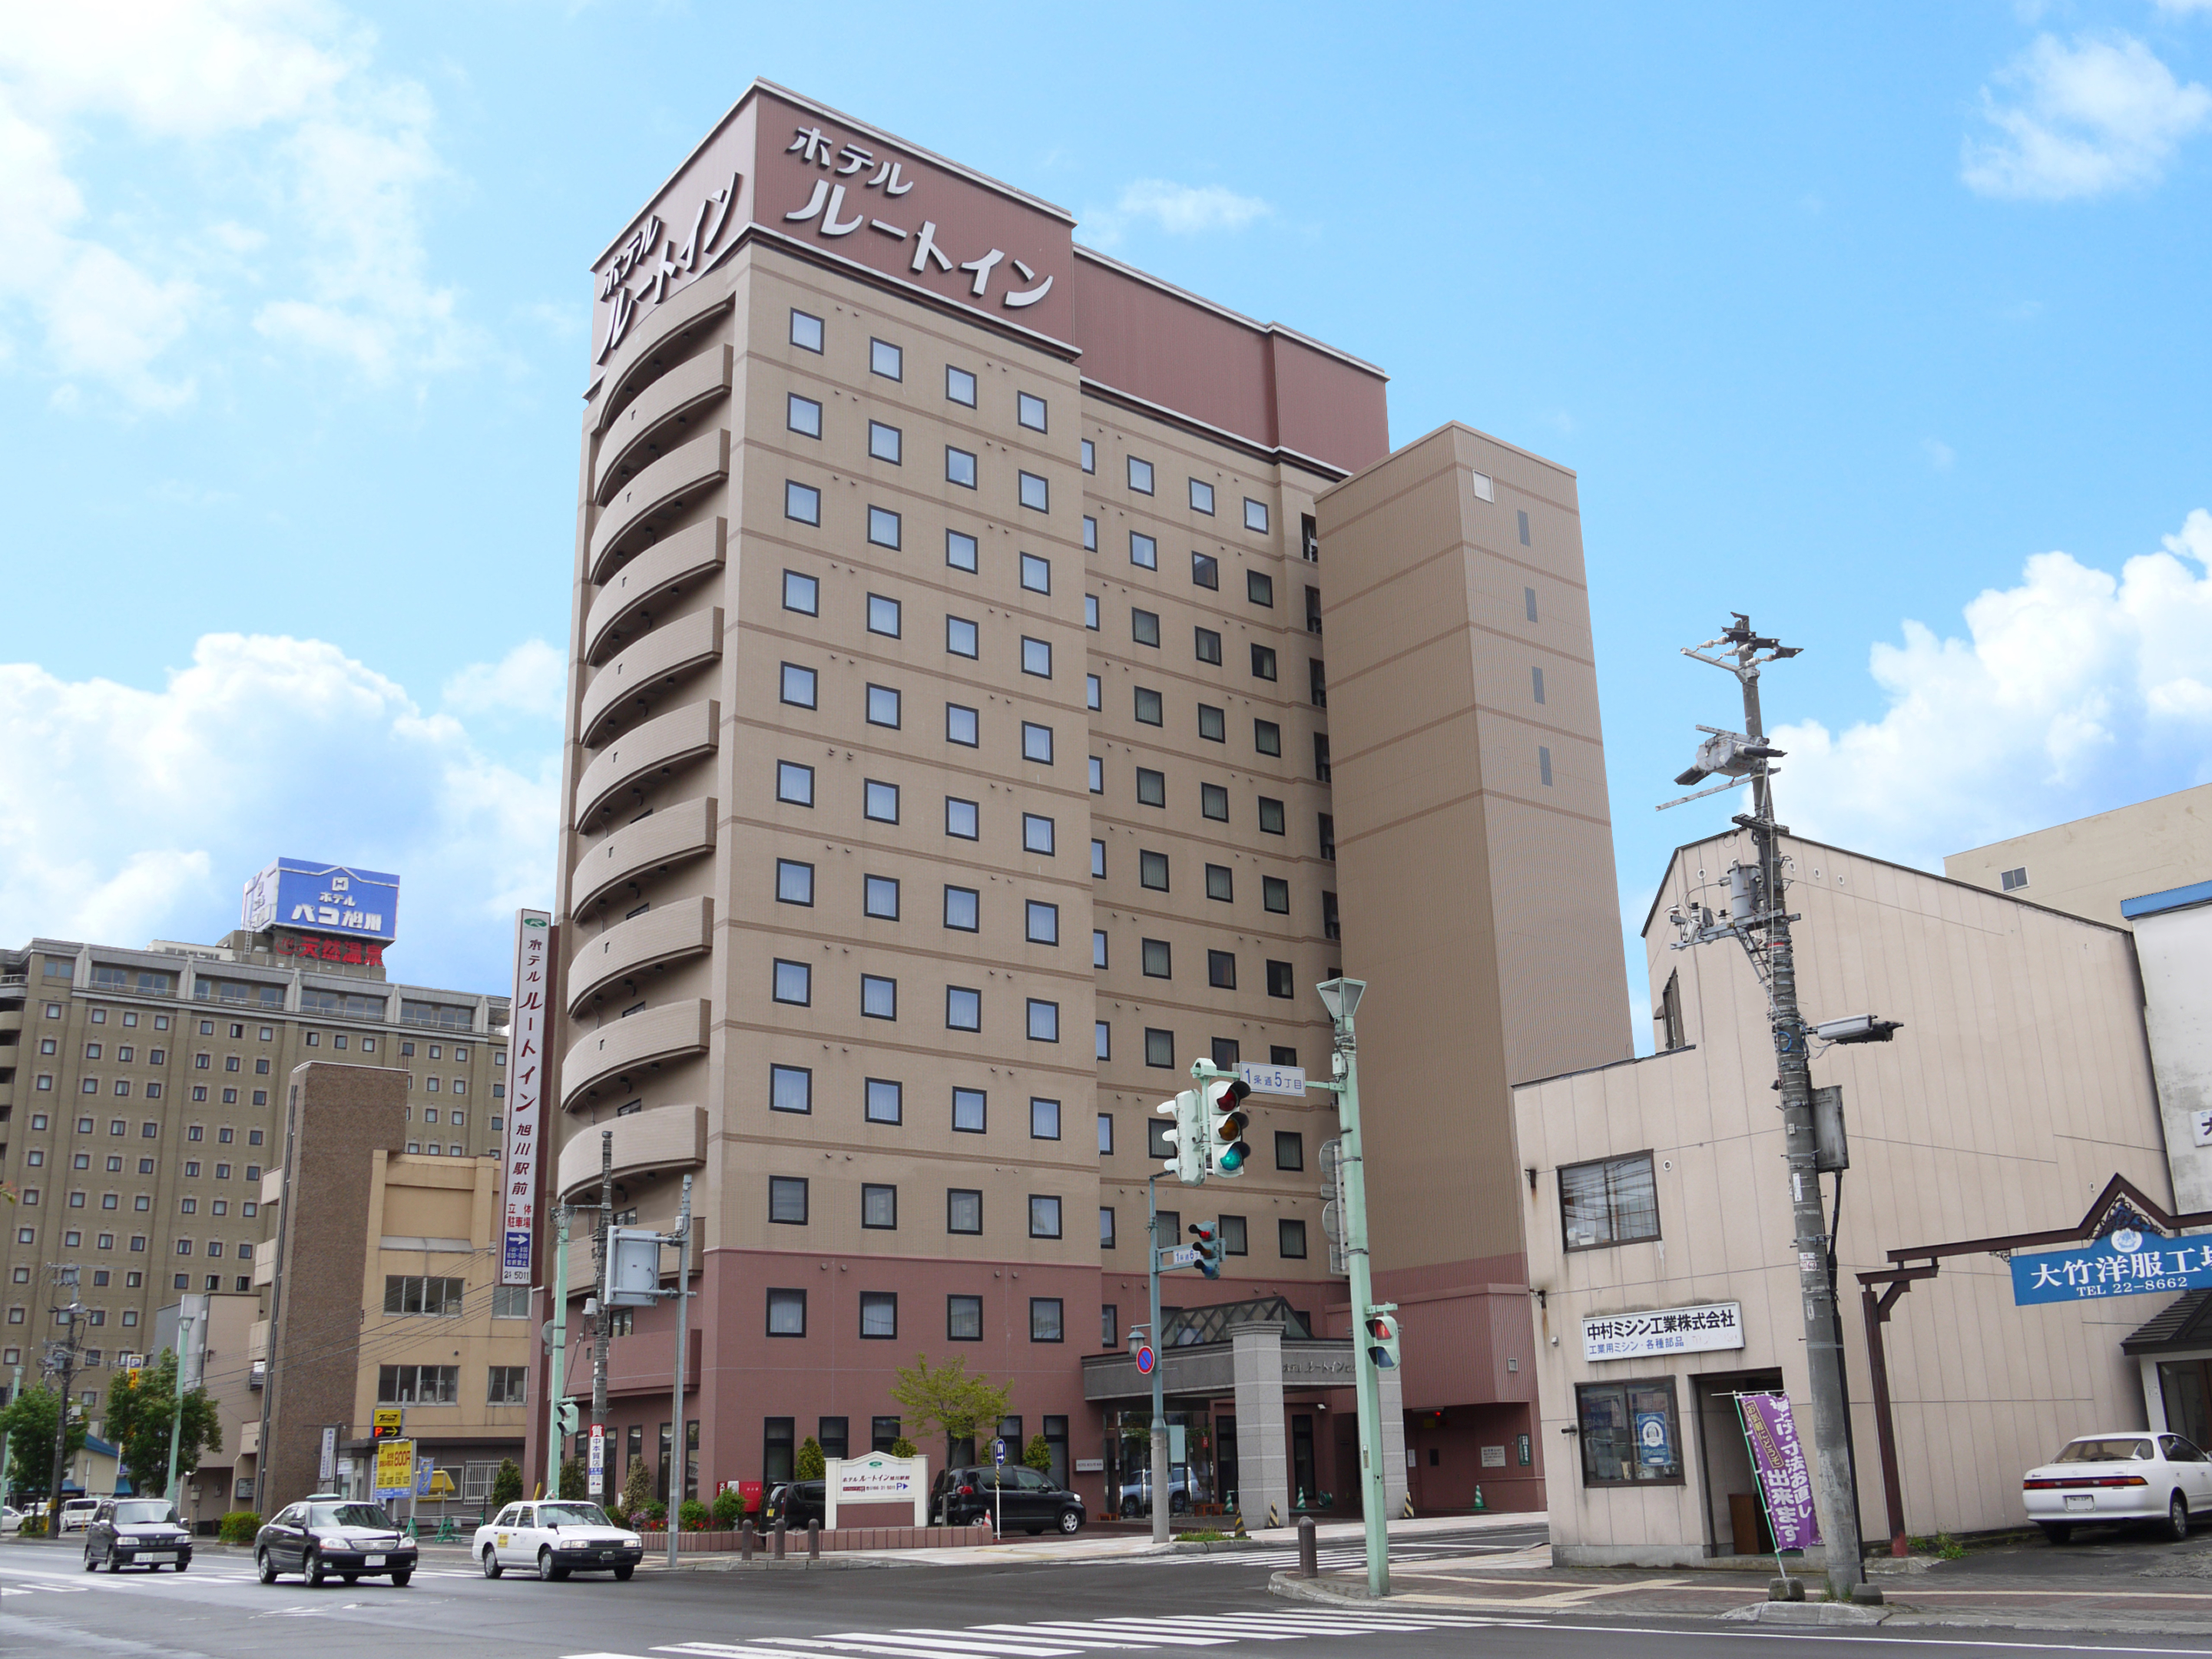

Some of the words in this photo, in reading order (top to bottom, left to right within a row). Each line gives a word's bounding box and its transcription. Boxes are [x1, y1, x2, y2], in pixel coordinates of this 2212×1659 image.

[788, 126, 914, 196] ホテル
[784, 178, 1054, 308] ルートイン
[319, 892, 356, 907] ホテル
[298, 935, 382, 965] 天然温泉
[1245, 1068, 1302, 1089] 1条通5丁目
[508, 1217, 530, 1229] 駐車場
[2076, 1284, 2107, 1296] TEL
[2113, 1277, 2187, 1293] 22-8662
[1587, 1309, 1737, 1341] 中村ミシン工業株式会社
[375, 1427, 383, 1437] P
[1767, 1469, 1800, 1542] 出来ます
